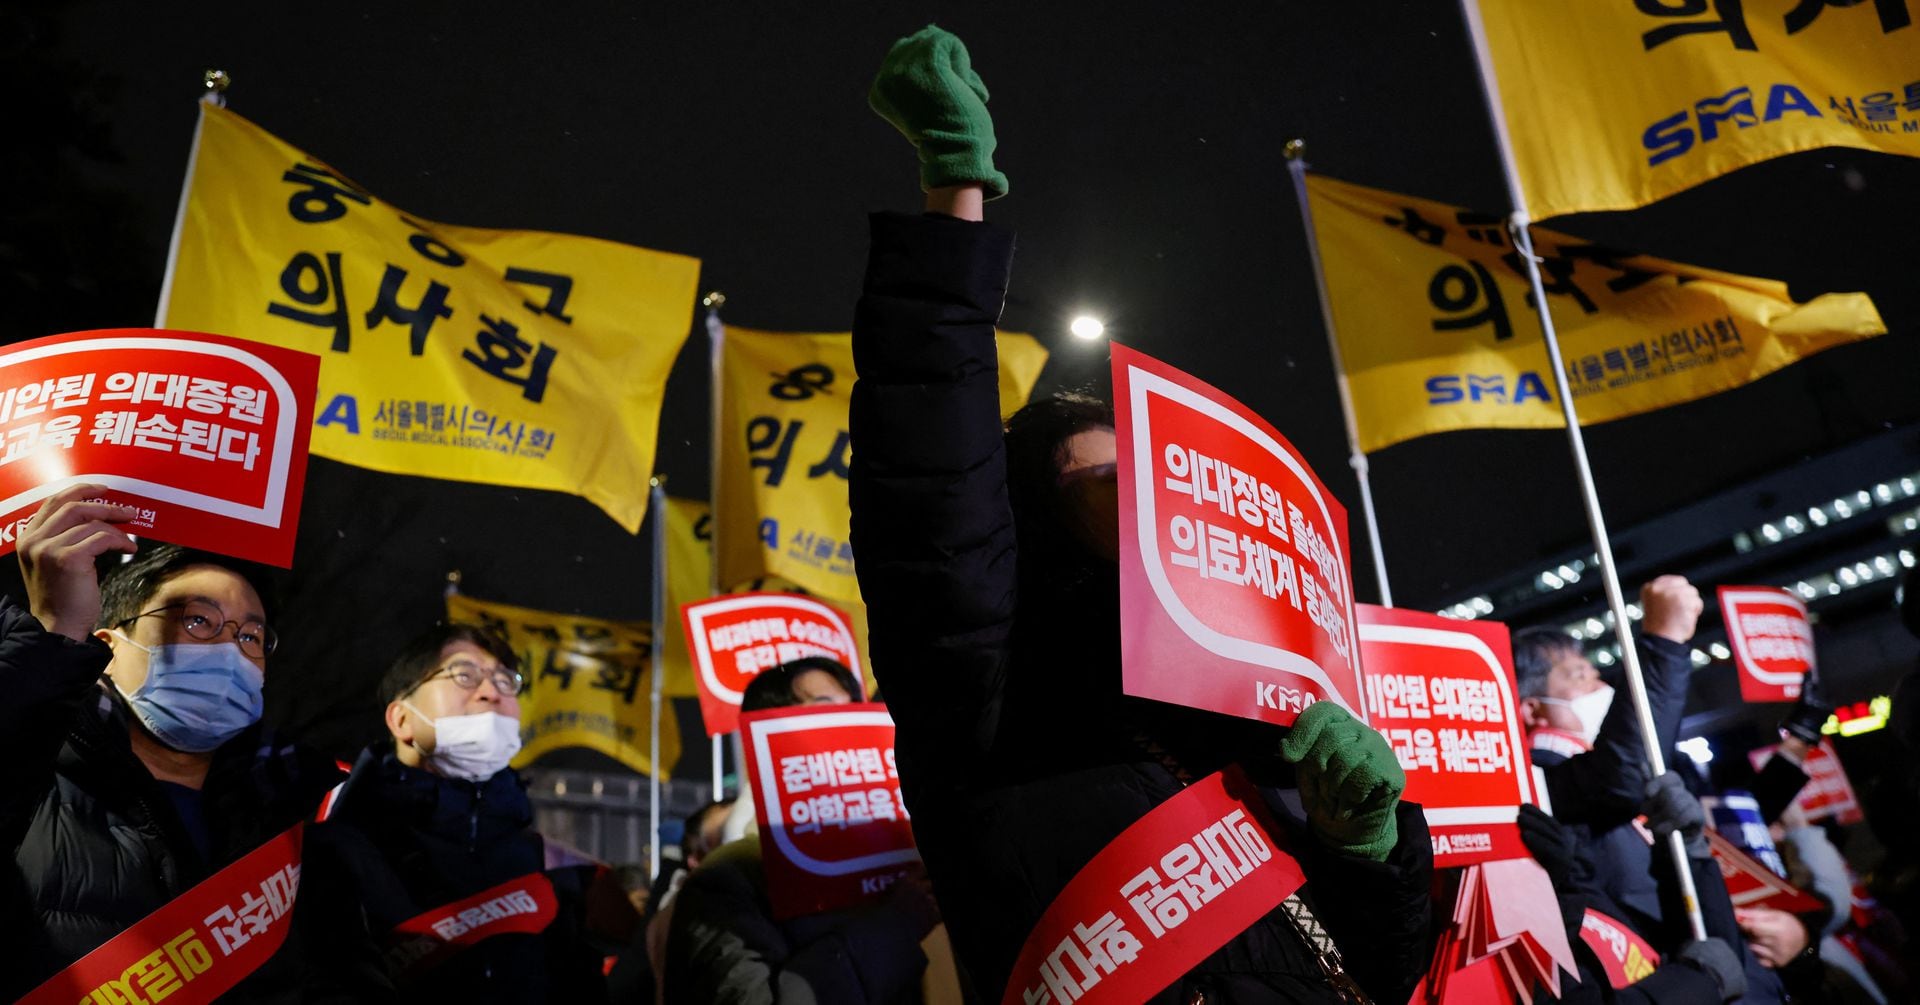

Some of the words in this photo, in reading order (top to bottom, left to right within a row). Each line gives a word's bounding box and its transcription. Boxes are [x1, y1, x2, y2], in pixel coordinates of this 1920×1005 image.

[1641, 84, 1824, 167] SMA
[267, 252, 558, 402] 의사회
[100, 372, 267, 425] 의대증원
[1424, 373, 1552, 407] SMA
[0, 415, 82, 467] 교육
[89, 411, 261, 471] 훼손된다
[373, 399, 555, 453] 서울특별시의사회
[1165, 443, 1290, 543] 의대정원
[1287, 499, 1344, 608] 졸속확대
[1170, 514, 1303, 612] 의료체계
[1300, 564, 1352, 670] 붕괴된다
[1430, 676, 1504, 722] 의대증원
[780, 746, 887, 795] 준비안된
[1380, 727, 1440, 773] 교육
[1438, 728, 1512, 774] 훼손된다
[790, 787, 897, 835] 의학교육
[1120, 808, 1272, 939] 의대정원
[430, 889, 539, 942] 의대정원
